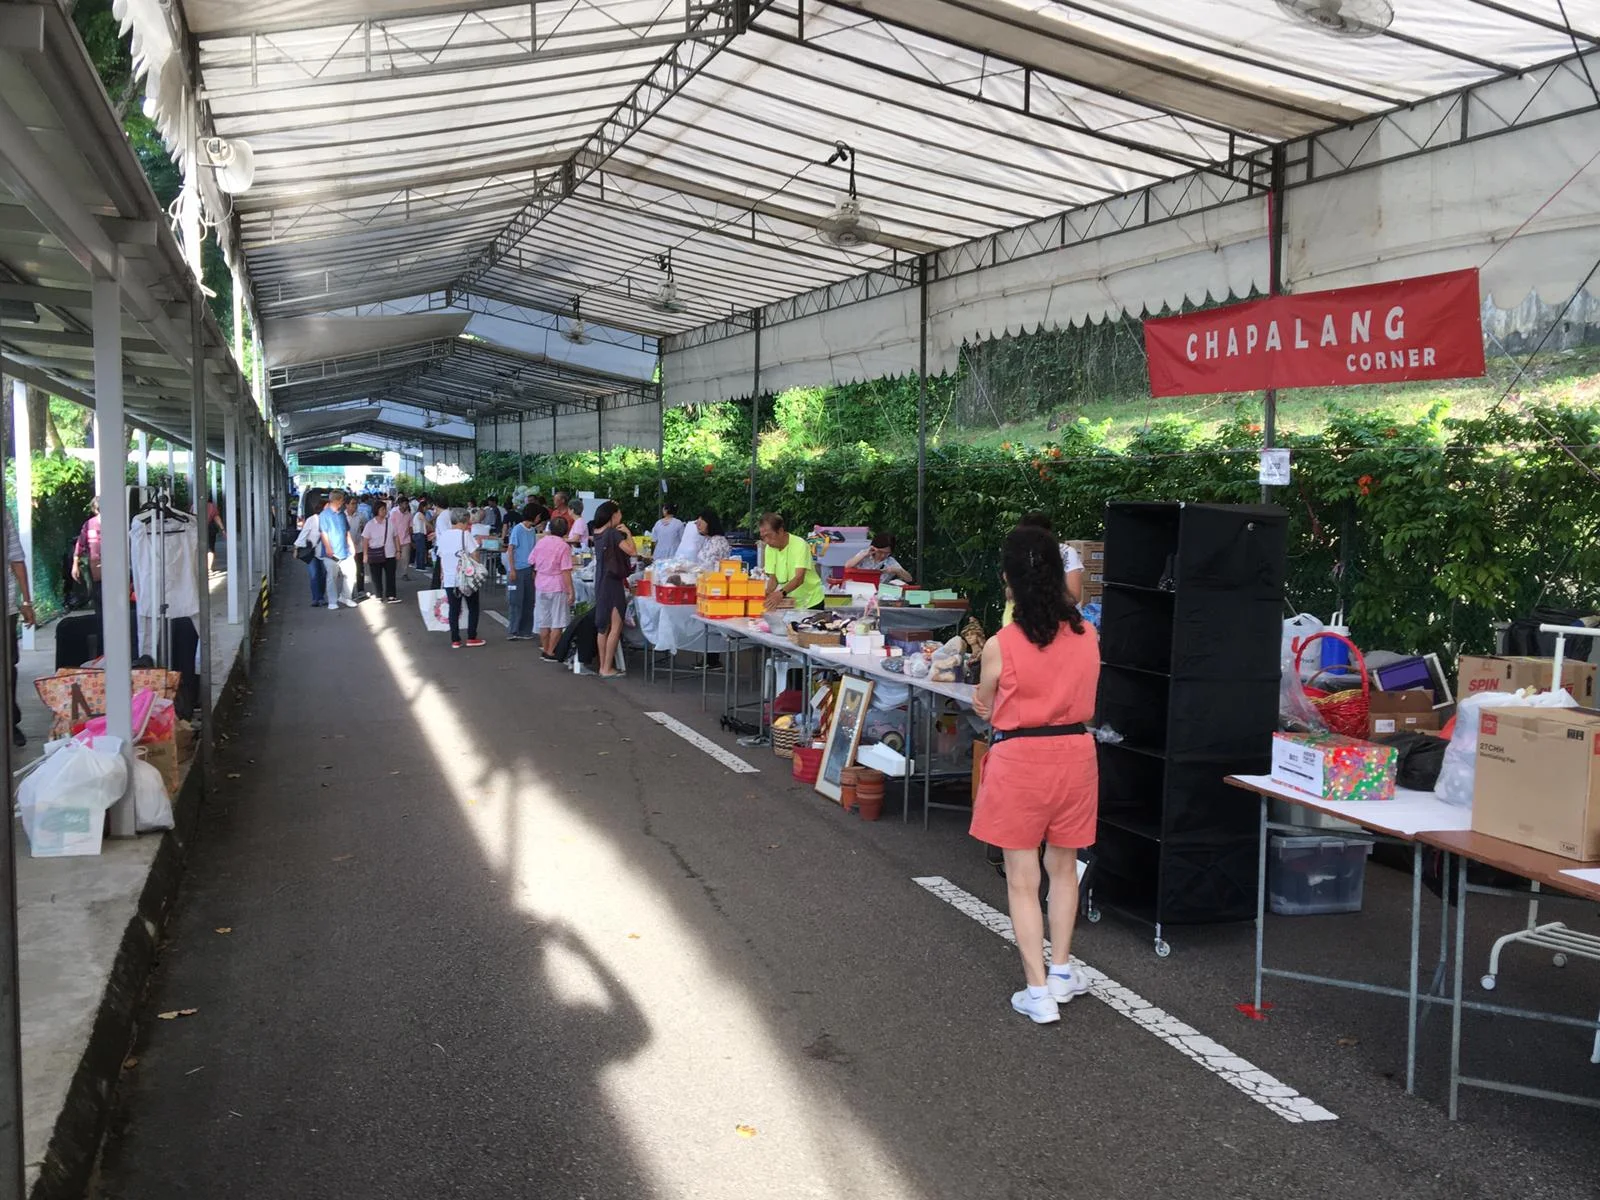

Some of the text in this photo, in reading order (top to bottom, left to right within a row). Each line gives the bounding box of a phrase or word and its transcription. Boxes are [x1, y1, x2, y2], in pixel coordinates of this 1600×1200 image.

[1187, 306, 1404, 361] CHAPALANG
[1347, 348, 1436, 372] CORNER
[1468, 679, 1499, 692] SPIN
